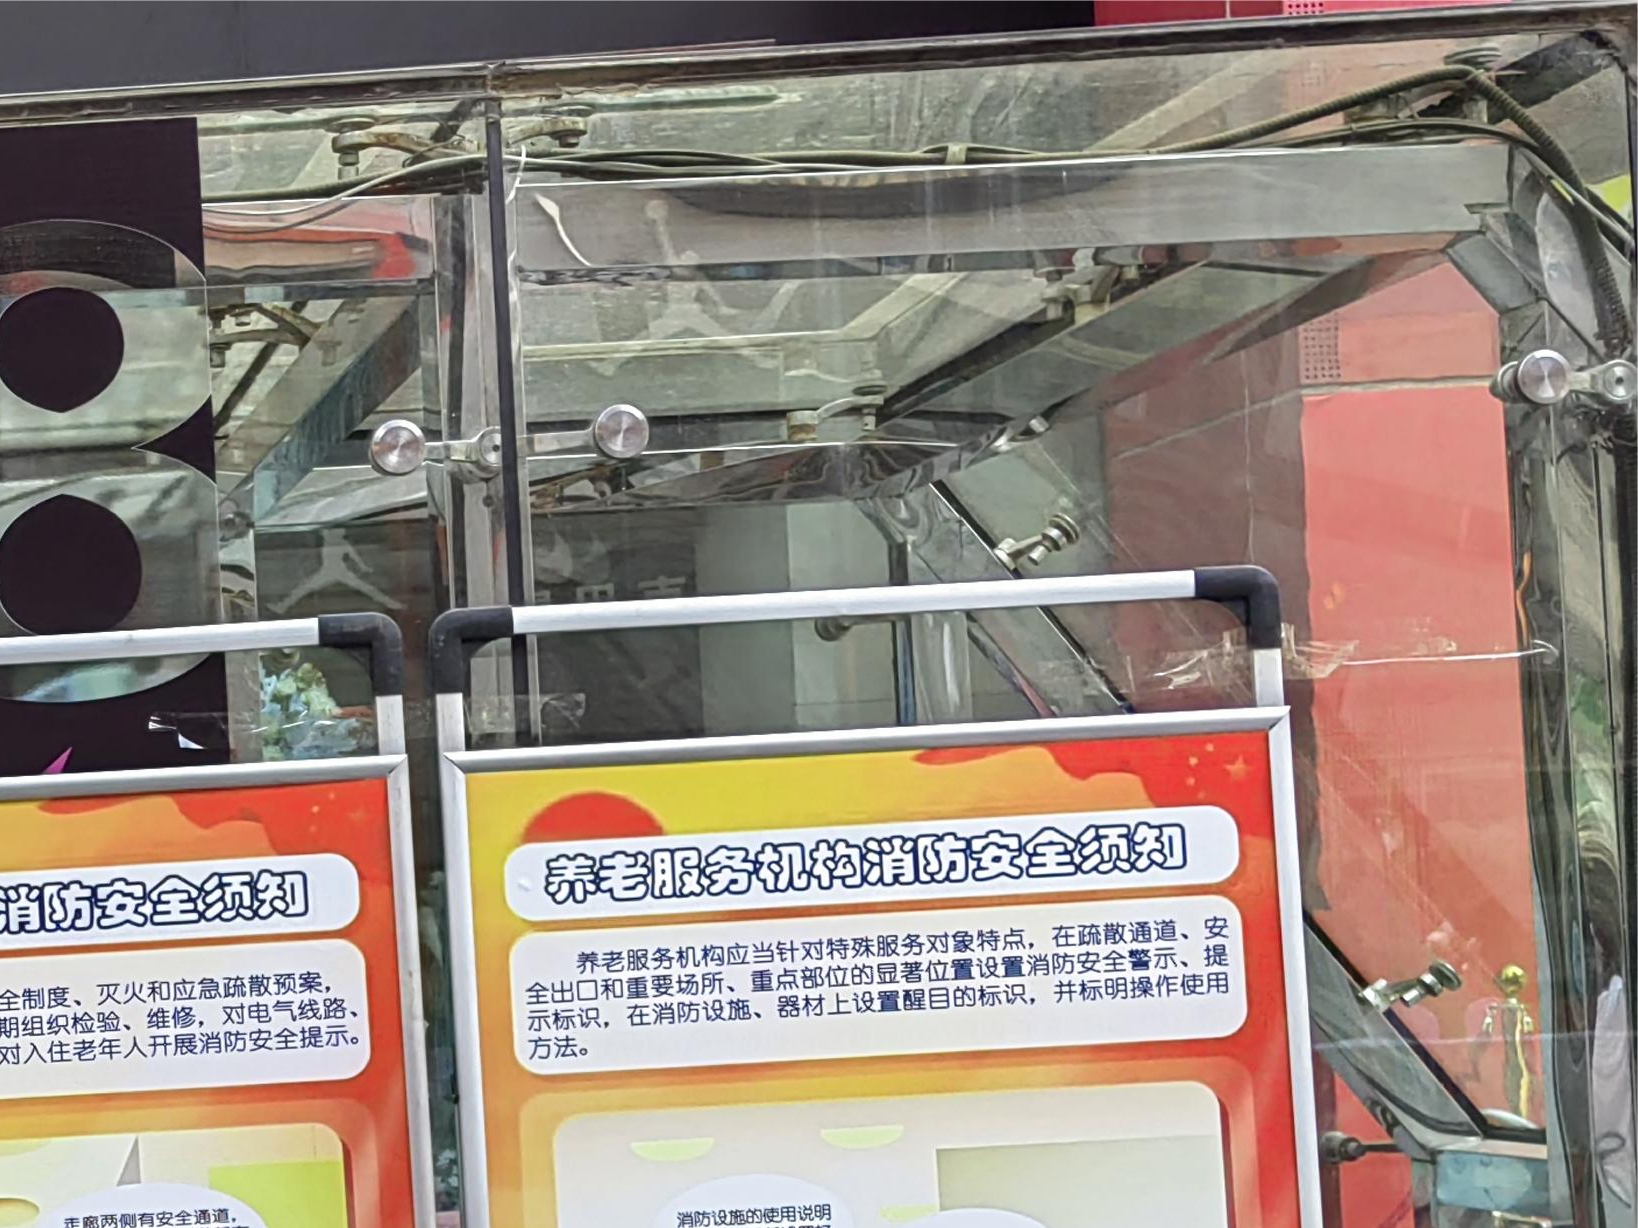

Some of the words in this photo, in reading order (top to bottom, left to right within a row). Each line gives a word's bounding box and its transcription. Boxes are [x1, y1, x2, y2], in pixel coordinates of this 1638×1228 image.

[545, 822, 1187, 904] 养老服务机构消防安全须知
[525, 944, 1229, 1005] 全出口和重要场所、重点部位的显著位置设置消防安全警示、提
[576, 916, 1229, 974] 养老服务机构应当针对特殊服务对象特点，在疏散通道、安
[527, 972, 1228, 1032] 示标识，在消防设施、器材上设置醒目的标识，并标明操作使用
[528, 1035, 589, 1061] 方法。
[677, 1203, 832, 1228] 消防设施的使用说明
